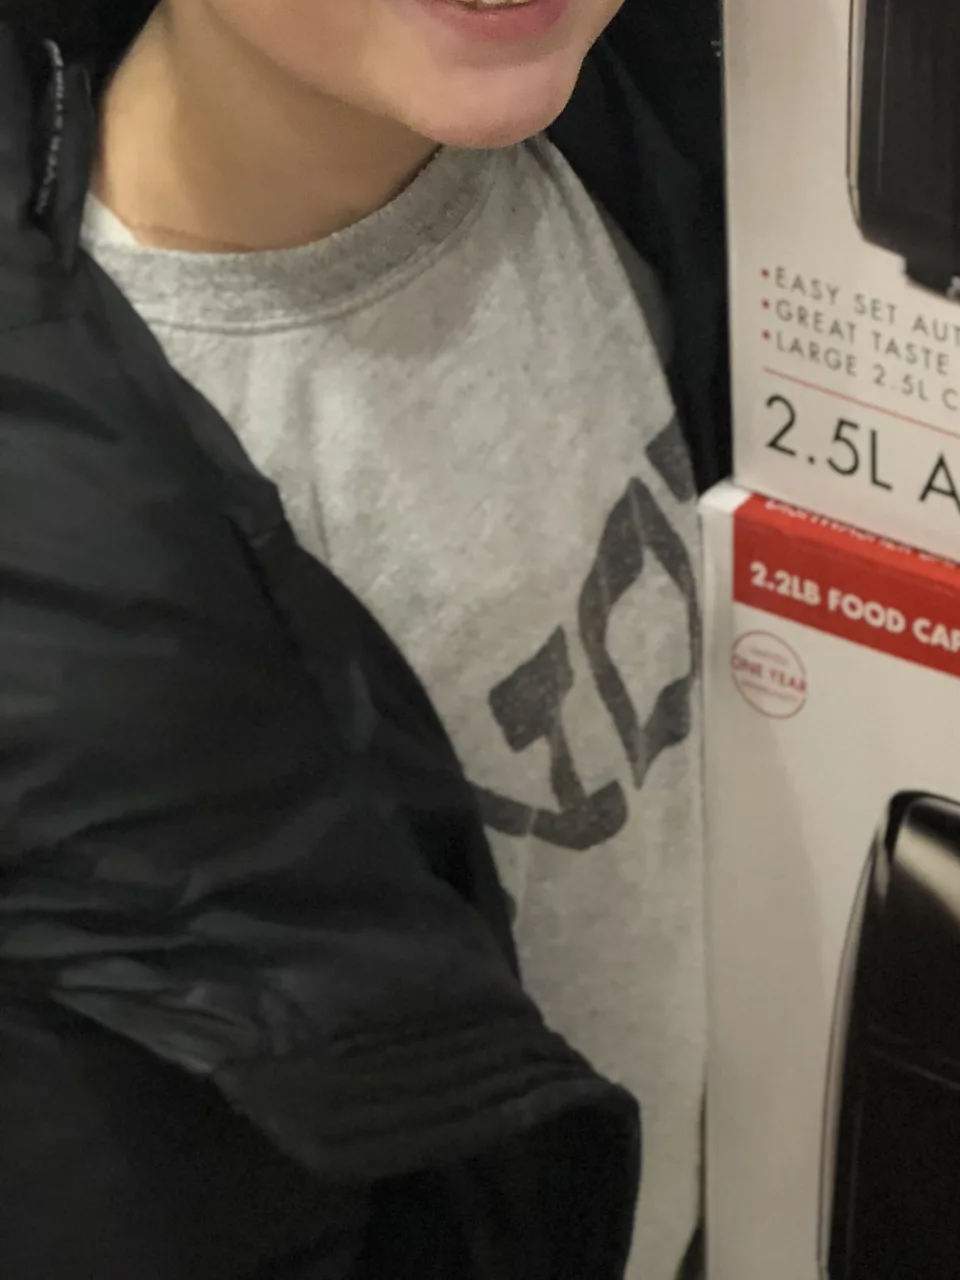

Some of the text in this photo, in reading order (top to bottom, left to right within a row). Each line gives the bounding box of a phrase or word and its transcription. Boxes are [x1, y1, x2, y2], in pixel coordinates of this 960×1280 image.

[775, 267, 840, 305] EASY
[854, 295, 898, 325] SET
[775, 300, 857, 345] GREAT
[873, 331, 950, 376] TASTE
[775, 330, 858, 377] LARGE
[873, 369, 930, 402] 2.5L
[765, 394, 893, 491] 2.5L
[749, 561, 821, 607] 2.2LB
[827, 588, 906, 635] FOOD
